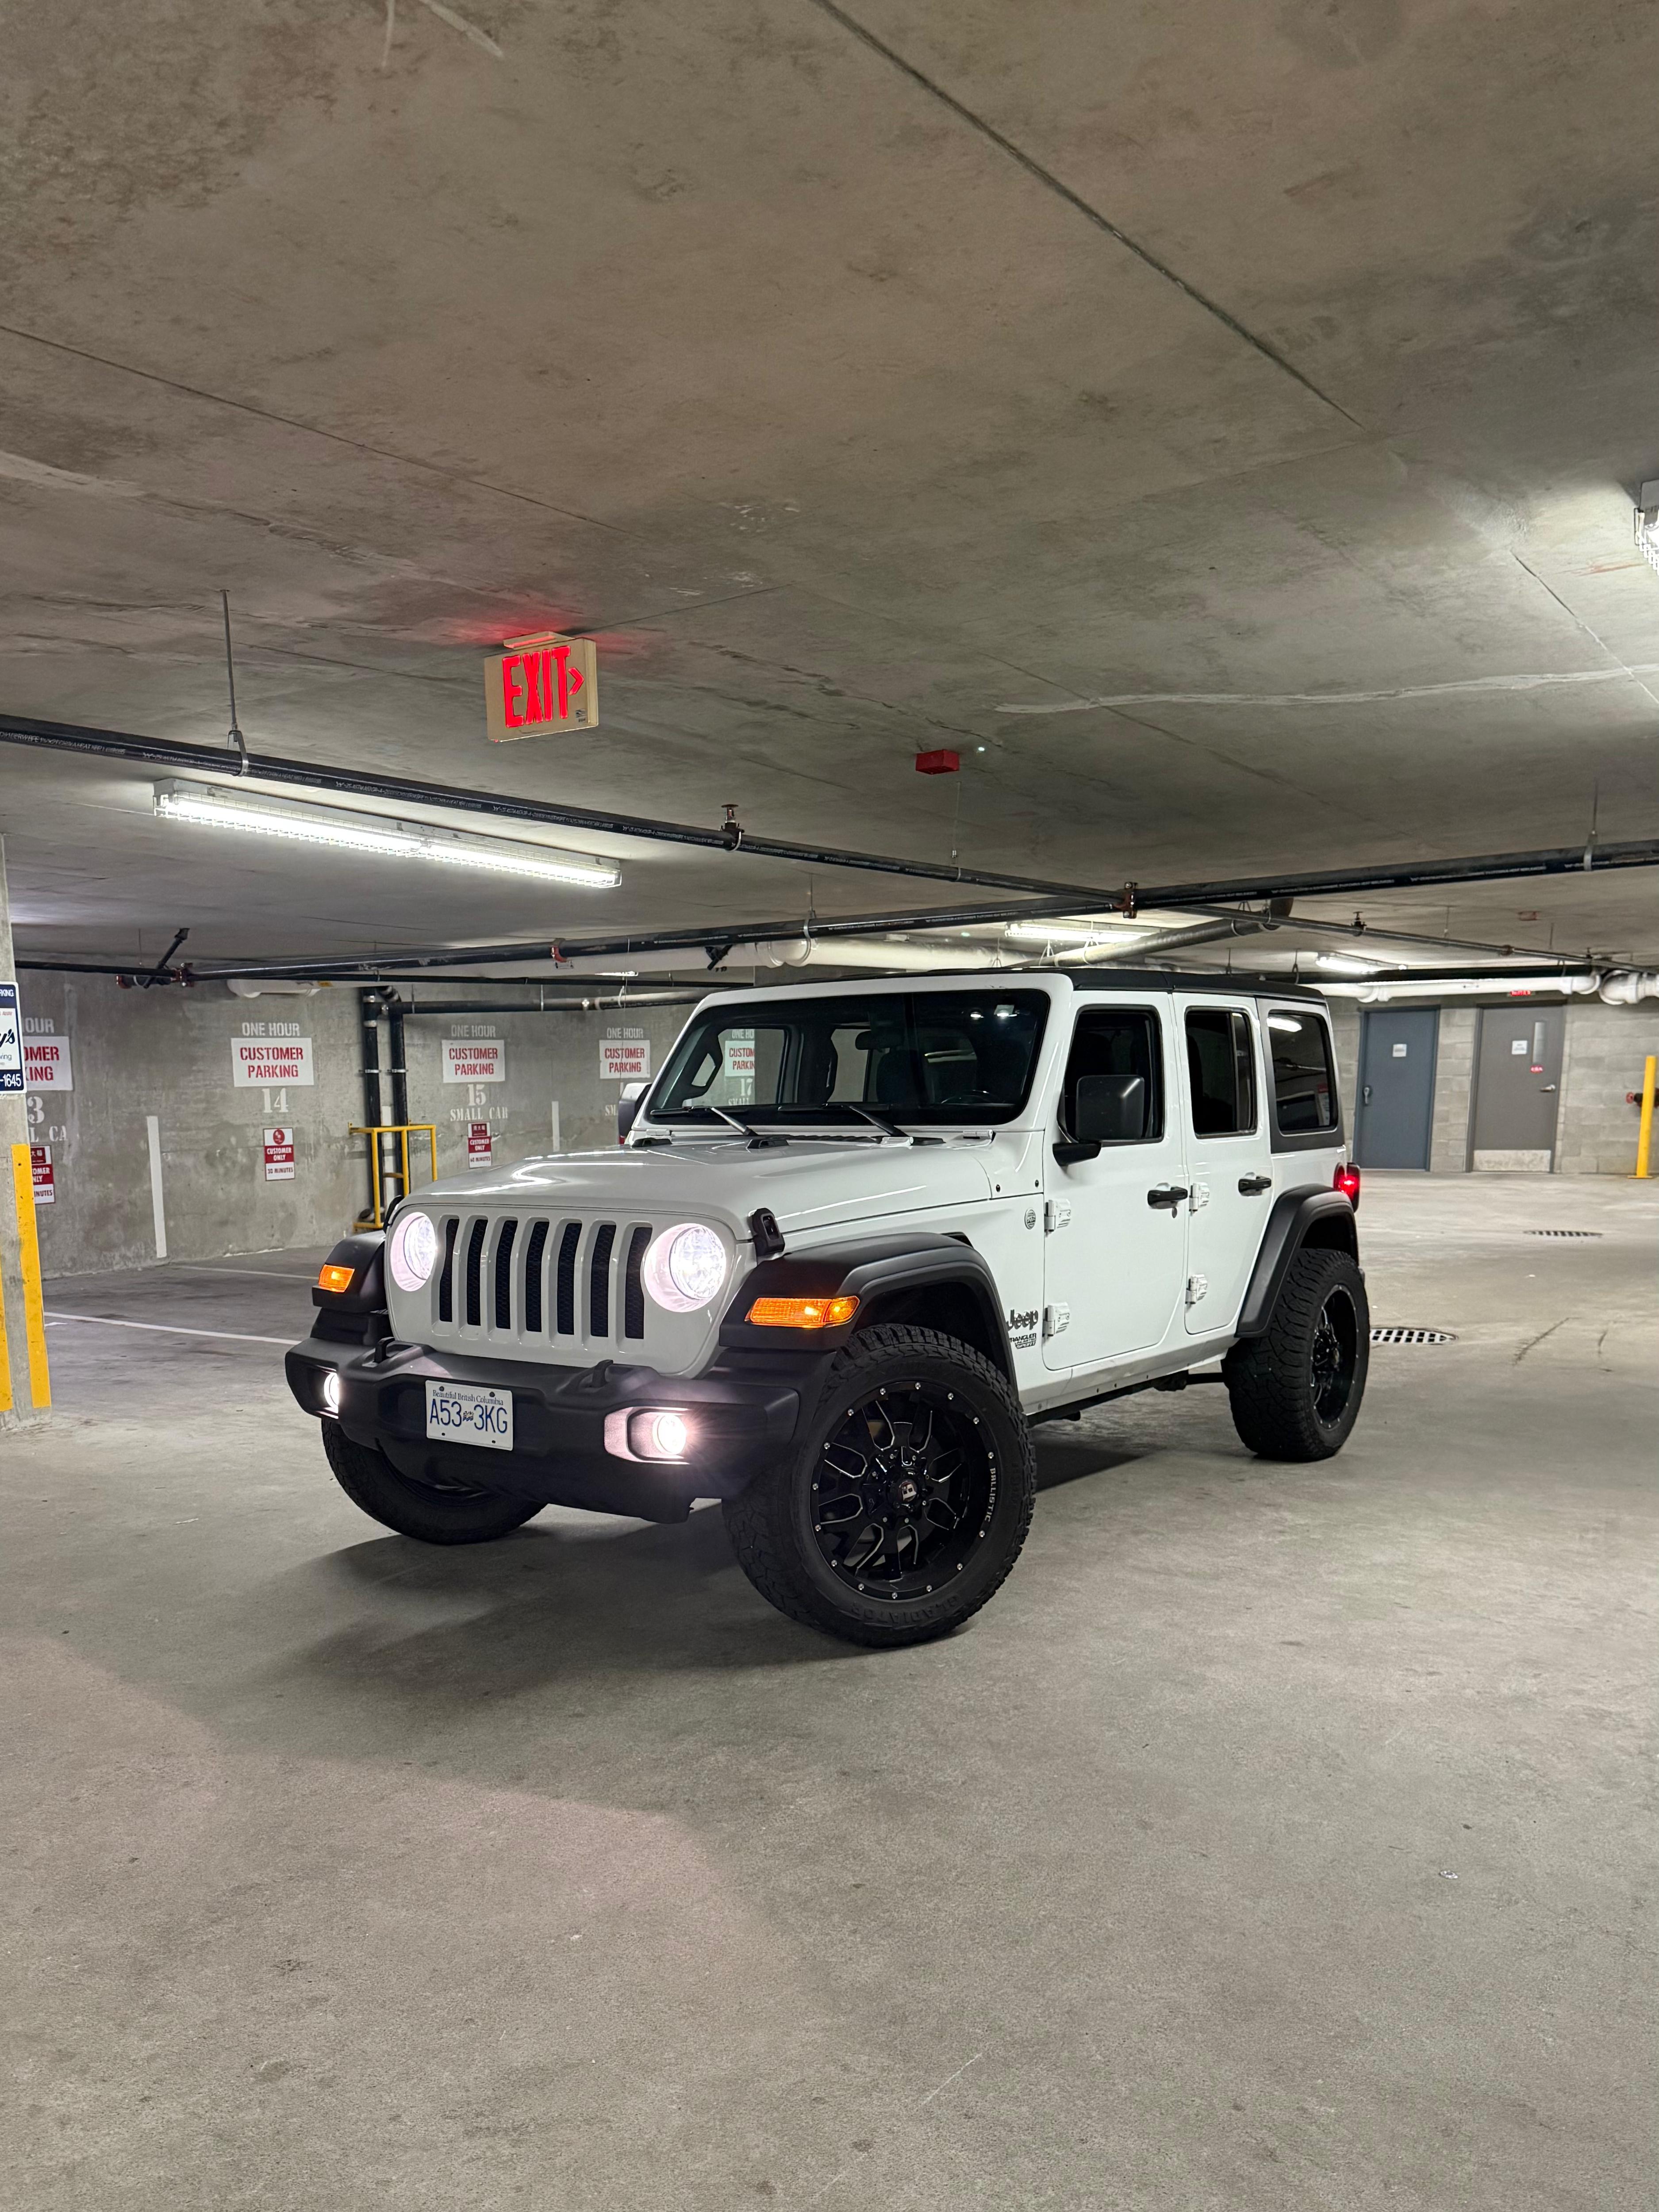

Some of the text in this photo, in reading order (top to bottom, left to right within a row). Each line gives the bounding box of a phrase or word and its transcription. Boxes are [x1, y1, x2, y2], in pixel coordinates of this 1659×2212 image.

[502, 645, 571, 728] EXIT
[22, 1017, 54, 1033] OUR
[242, 1022, 300, 1036] ONE HOUR
[451, 1025, 496, 1037] ONE HOUR
[607, 1027, 643, 1038] ONE HOUR
[732, 1029, 744, 1039] ONE
[240, 1047, 303, 1060] CUSTOMER
[449, 1048, 498, 1060] CUSTOMER
[605, 1048, 645, 1059] CUSTOMER
[248, 1064, 299, 1078] PARKING
[455, 1063, 494, 1075] PARKING
[609, 1062, 641, 1073] PARKING
[740, 1078, 753, 1096] 17
[261, 1088, 288, 1113] 14
[467, 1084, 487, 1106] 15
[450, 1108, 483, 1121] SMALL
[1006, 1309, 1038, 1331] Jeep
[1010, 1333, 1037, 1343] RANGLER
[433, 1390, 503, 1406] Beautiful British Columbia
[430, 1398, 507, 1433] A53 3KG
[985, 1467, 996, 1522] BALLISTIC
